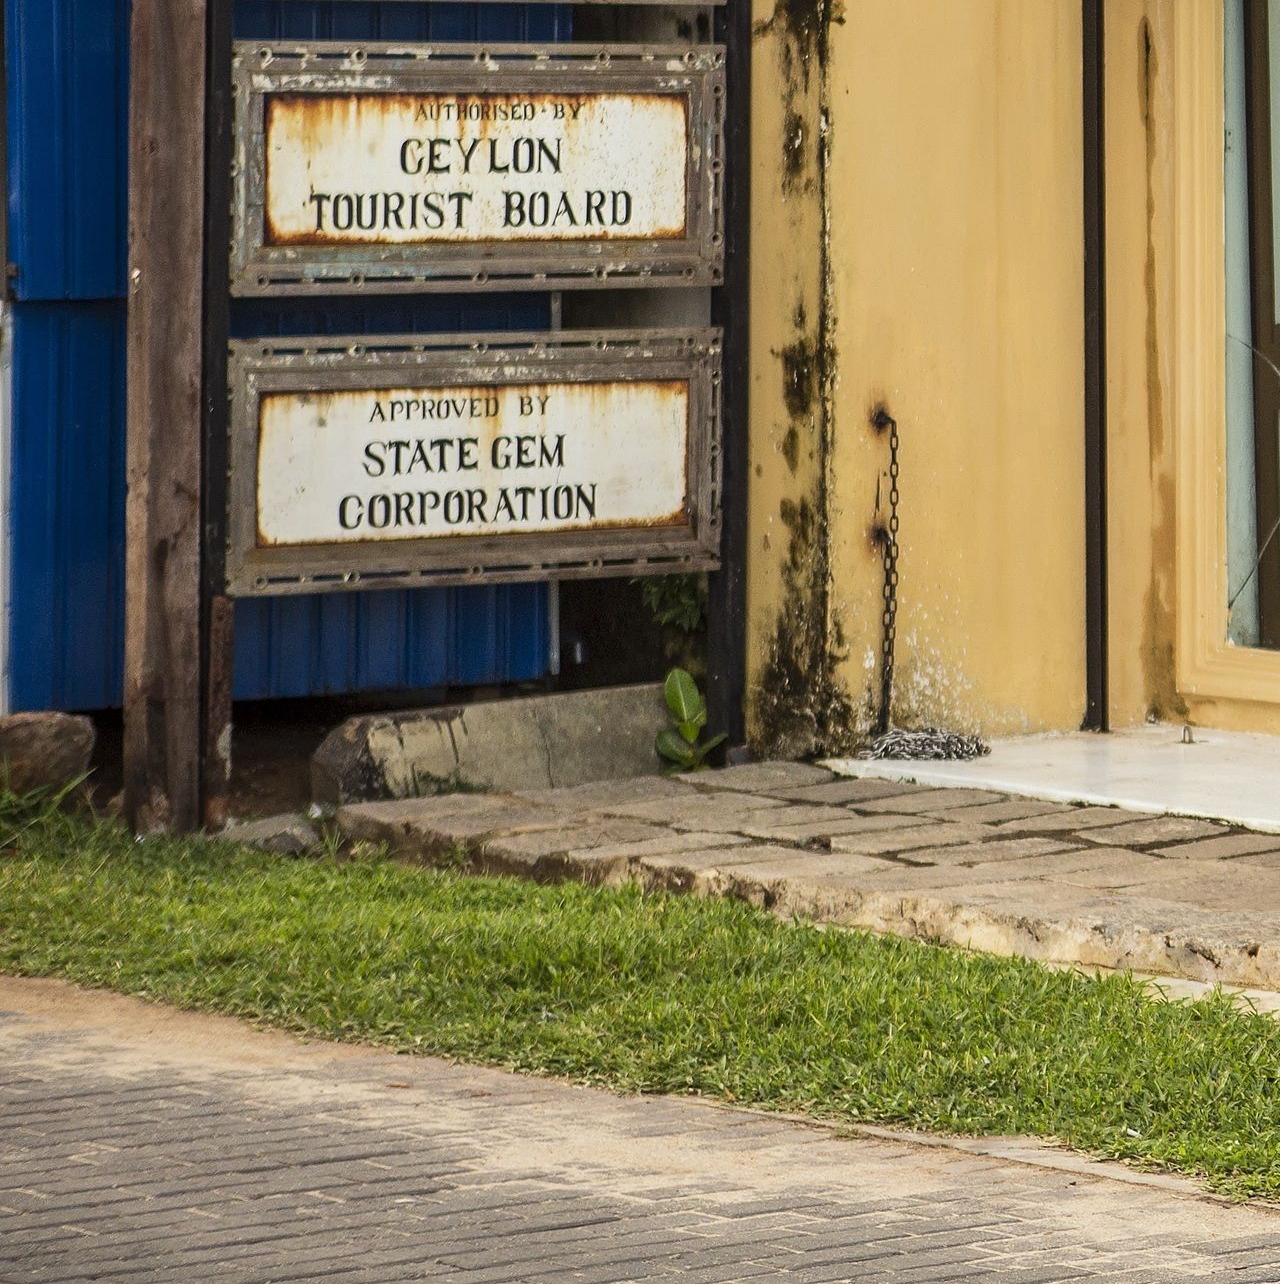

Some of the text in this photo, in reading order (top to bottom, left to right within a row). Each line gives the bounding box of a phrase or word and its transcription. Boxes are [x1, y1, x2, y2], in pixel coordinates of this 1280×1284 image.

[400, 137, 563, 175] CEYLON
[308, 190, 632, 232] TOURIST BOARD
[369, 395, 550, 423] APPROVED BY
[361, 435, 565, 477] STATE GEM
[338, 484, 598, 530] CORPORATION
